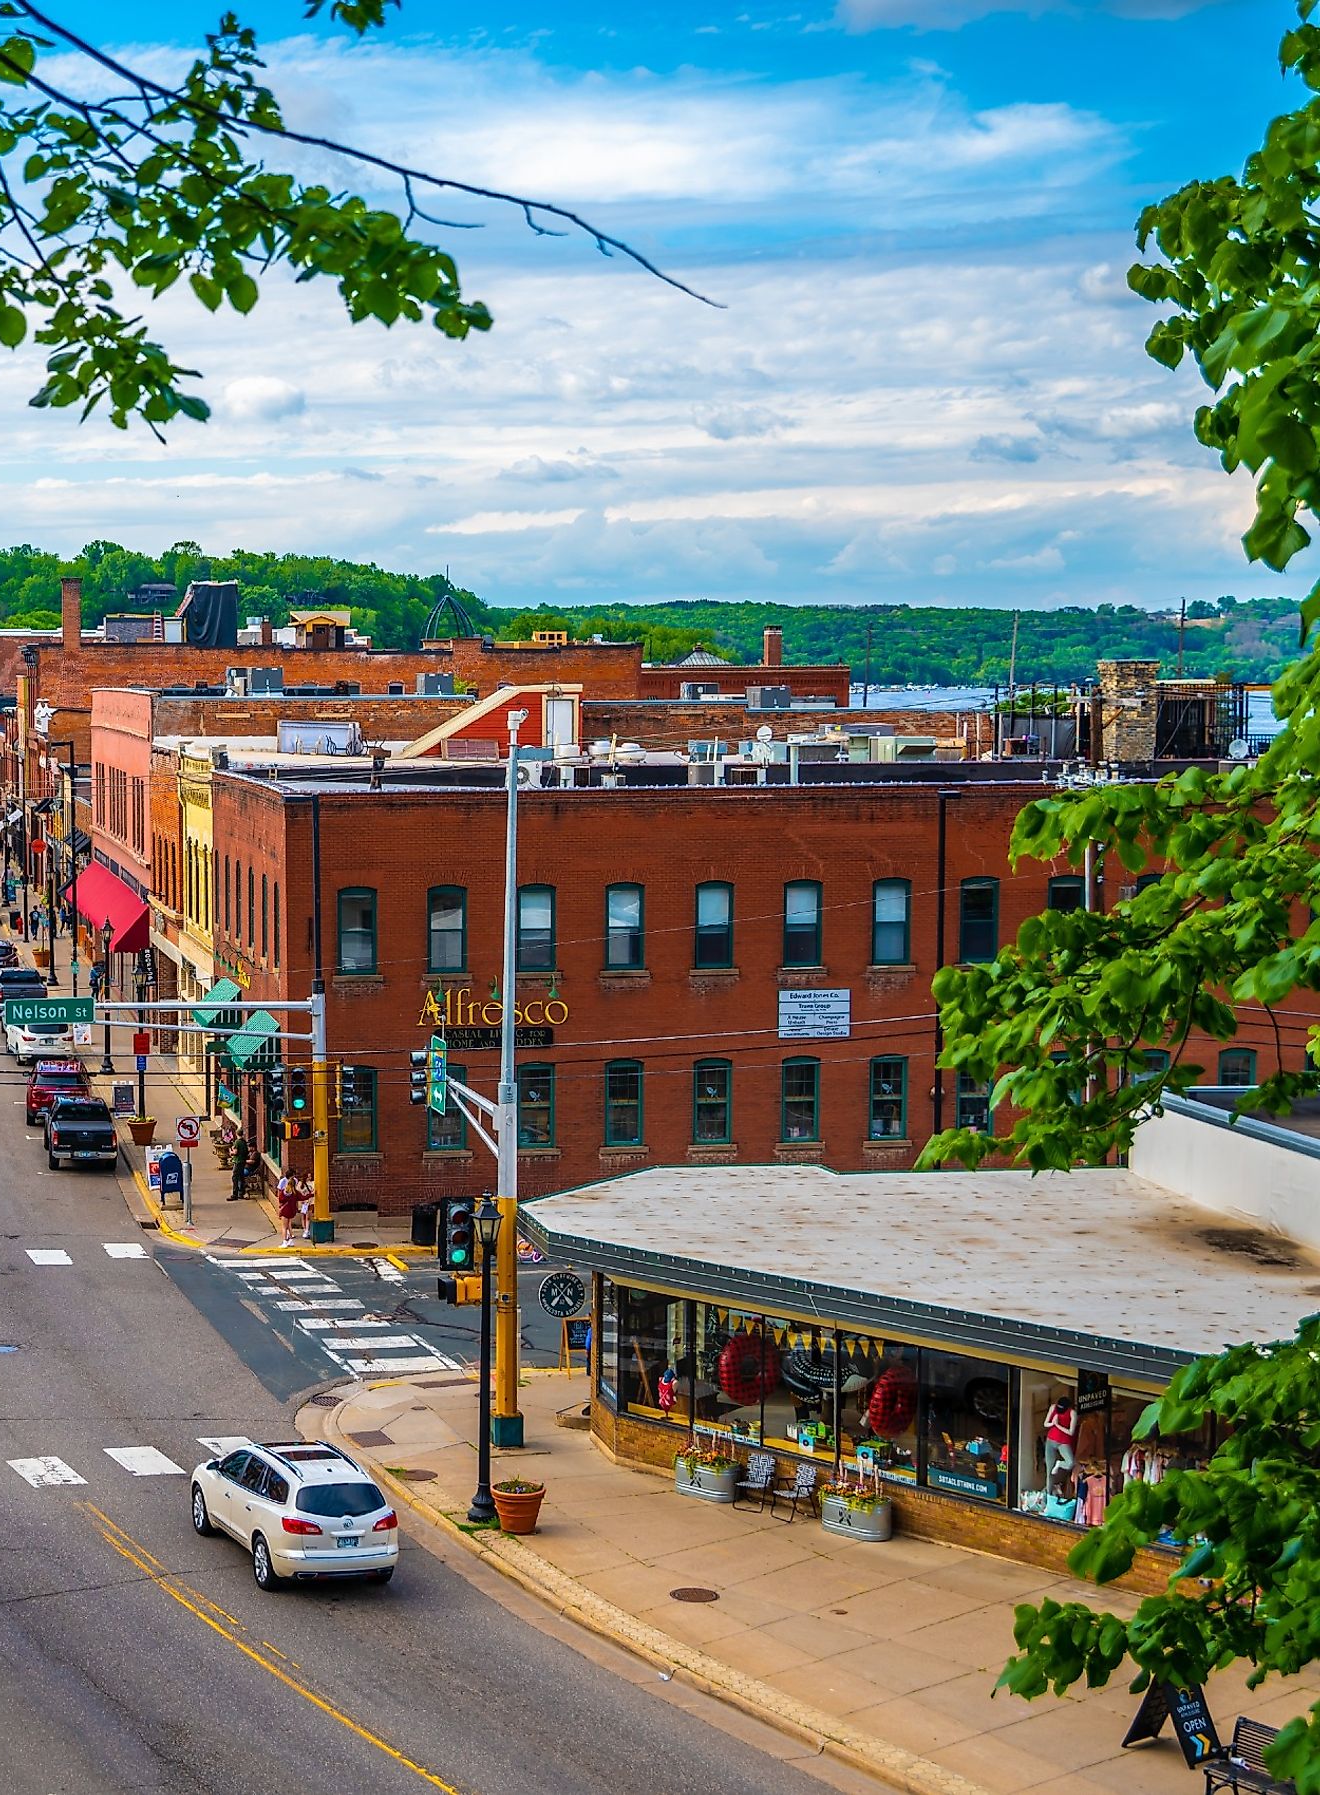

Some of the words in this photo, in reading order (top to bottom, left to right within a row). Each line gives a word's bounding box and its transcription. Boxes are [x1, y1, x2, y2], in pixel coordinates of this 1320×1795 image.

[12, 1004, 67, 1019] Nelson
[75, 1007, 87, 1017] St
[416, 988, 569, 1027] Alfresco
[444, 1029, 482, 1039] CASUAL
[1078, 1389, 1107, 1404] UNPAVED
[1183, 1716, 1207, 1733] OPEN
